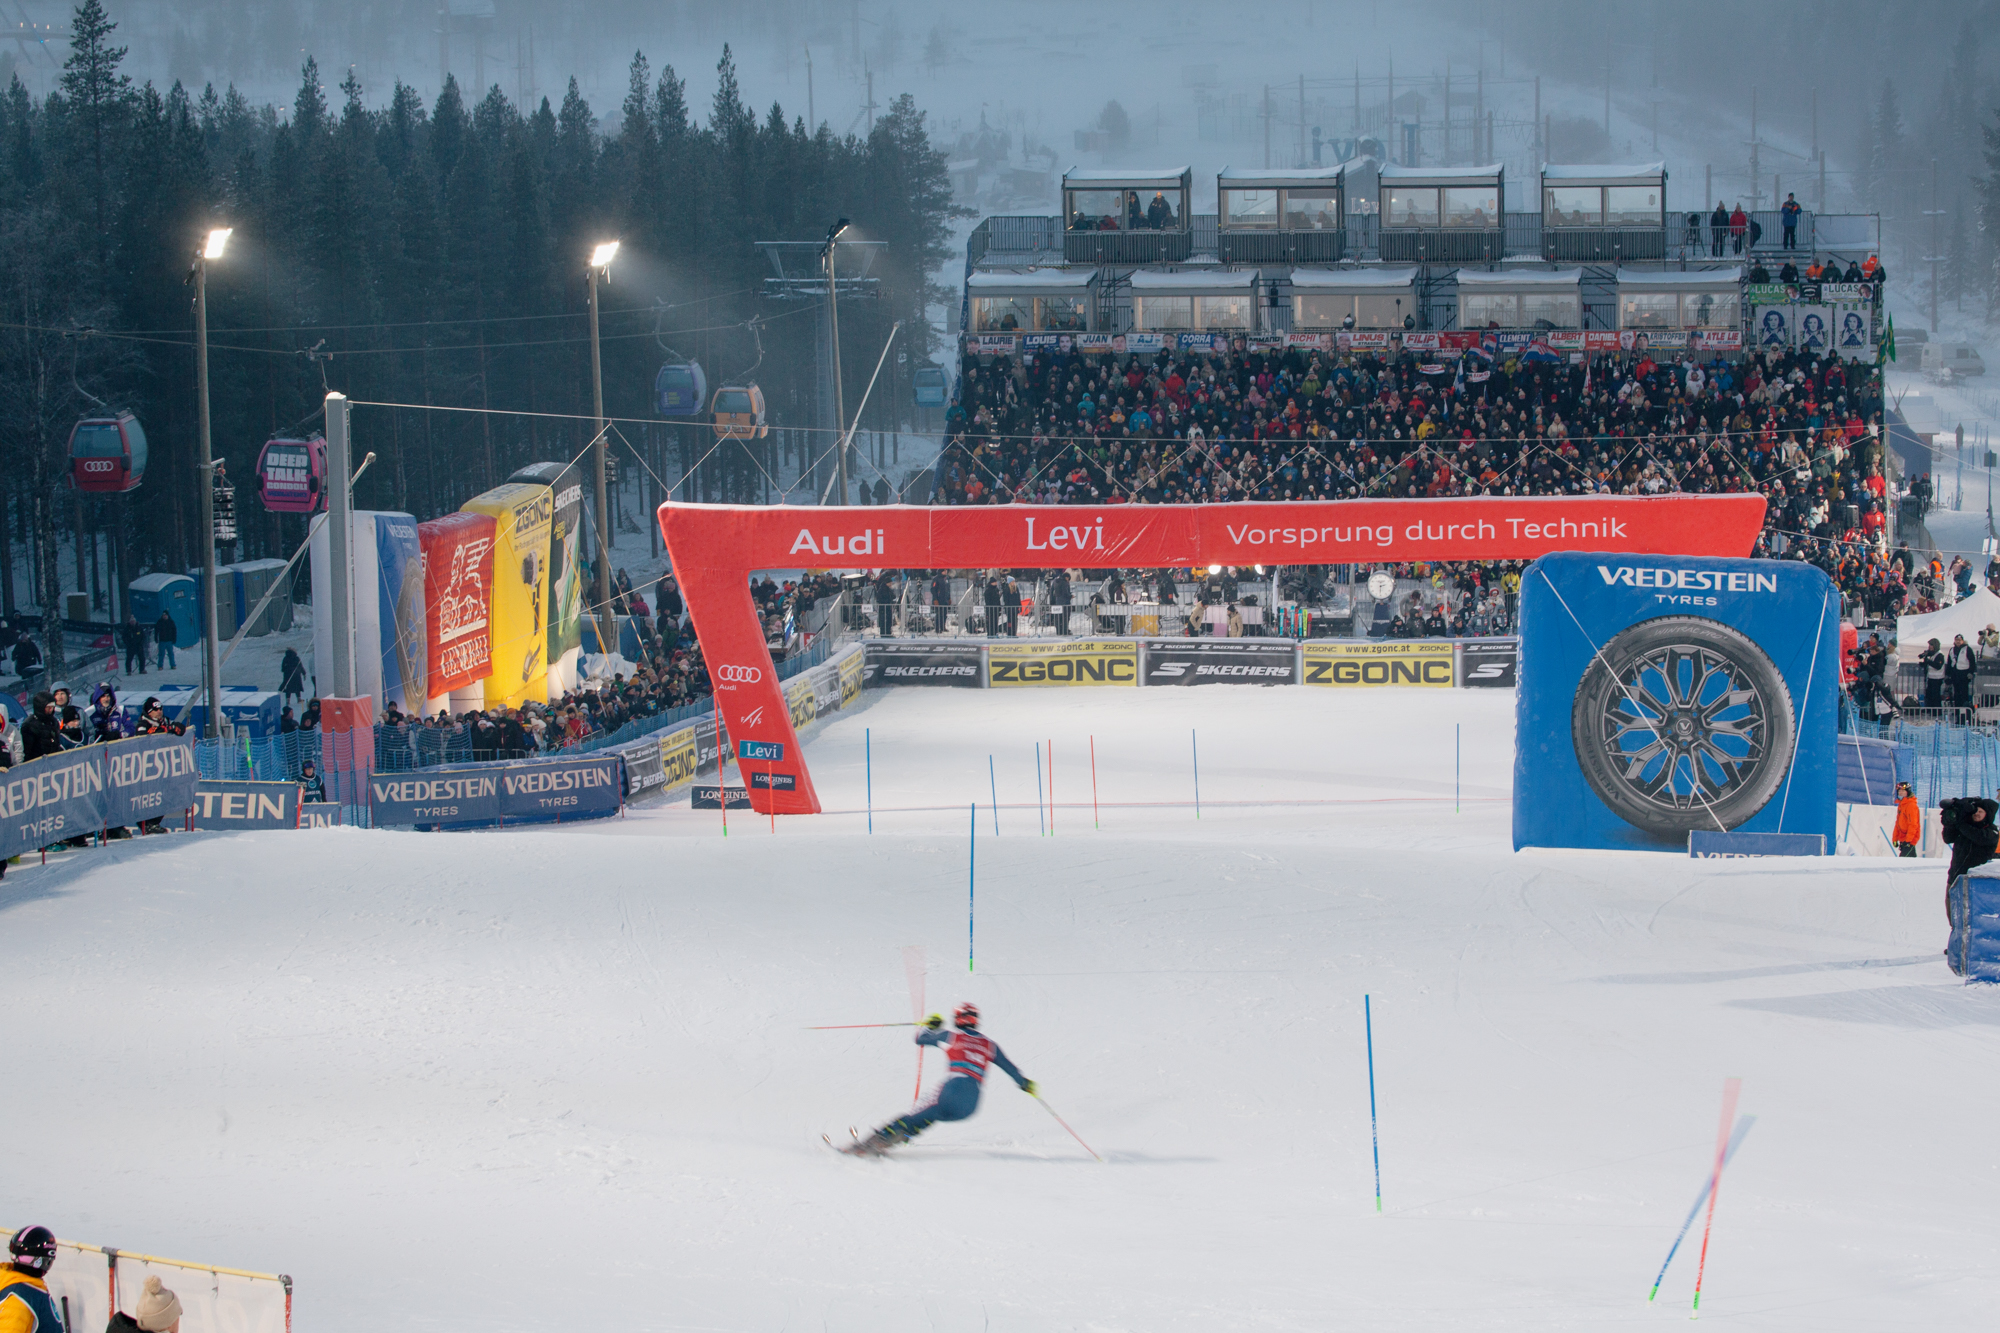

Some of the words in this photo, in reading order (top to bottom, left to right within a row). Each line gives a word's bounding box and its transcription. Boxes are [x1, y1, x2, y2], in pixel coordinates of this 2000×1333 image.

[1351, 197, 1380, 214] Lev
[1755, 285, 1785, 294] LUCAS
[1828, 284, 1859, 293] LUCAS
[982, 336, 1013, 345] LAURIE
[1026, 335, 1057, 345] LOUIS
[1083, 334, 1108, 343] JUAN
[1288, 334, 1316, 342] RICHI
[1352, 333, 1384, 342] LINUS
[1406, 334, 1435, 343] FILIP
[1550, 333, 1583, 341] ALBERT
[1588, 333, 1618, 342] DANIEL
[1650, 332, 1686, 341] KRISTOFFER
[1705, 333, 1725, 341] ATLE
[1727, 333, 1739, 341] LIE
[266, 466, 308, 483] TALK
[515, 497, 550, 534] ZGONC
[1025, 516, 1105, 551] Levi
[1226, 523, 1394, 548] Vorsprung
[1404, 518, 1496, 541] durch
[1505, 516, 1628, 540] Technik
[789, 528, 885, 555] Audi
[1597, 565, 1777, 593] VREDESTEIN
[1654, 594, 1718, 606] TYRES
[1654, 625, 1700, 637] WINTRAC
[1030, 642, 1095, 653] www.zgonc.at
[1345, 644, 1411, 653] www.zgonc.at
[884, 665, 978, 677] SKECHERS
[991, 658, 1135, 682] ZGONC
[1195, 664, 1292, 677] SKECHERS
[1305, 660, 1451, 684] ZGONC
[718, 683, 737, 691] Audi
[747, 742, 777, 759] Levi
[505, 766, 612, 795] VREDESTEIN
[755, 774, 793, 784] LONGINES
[0, 758, 103, 819] REDESTEIN
[373, 776, 497, 803] VREDESTEIN
[130, 791, 163, 812] TYRES
[539, 795, 579, 808] TYRES
[700, 790, 749, 801] LONGINE
[188, 791, 285, 820] TEIN
[413, 805, 459, 817] TYRES
[19, 814, 65, 841] TYRES
